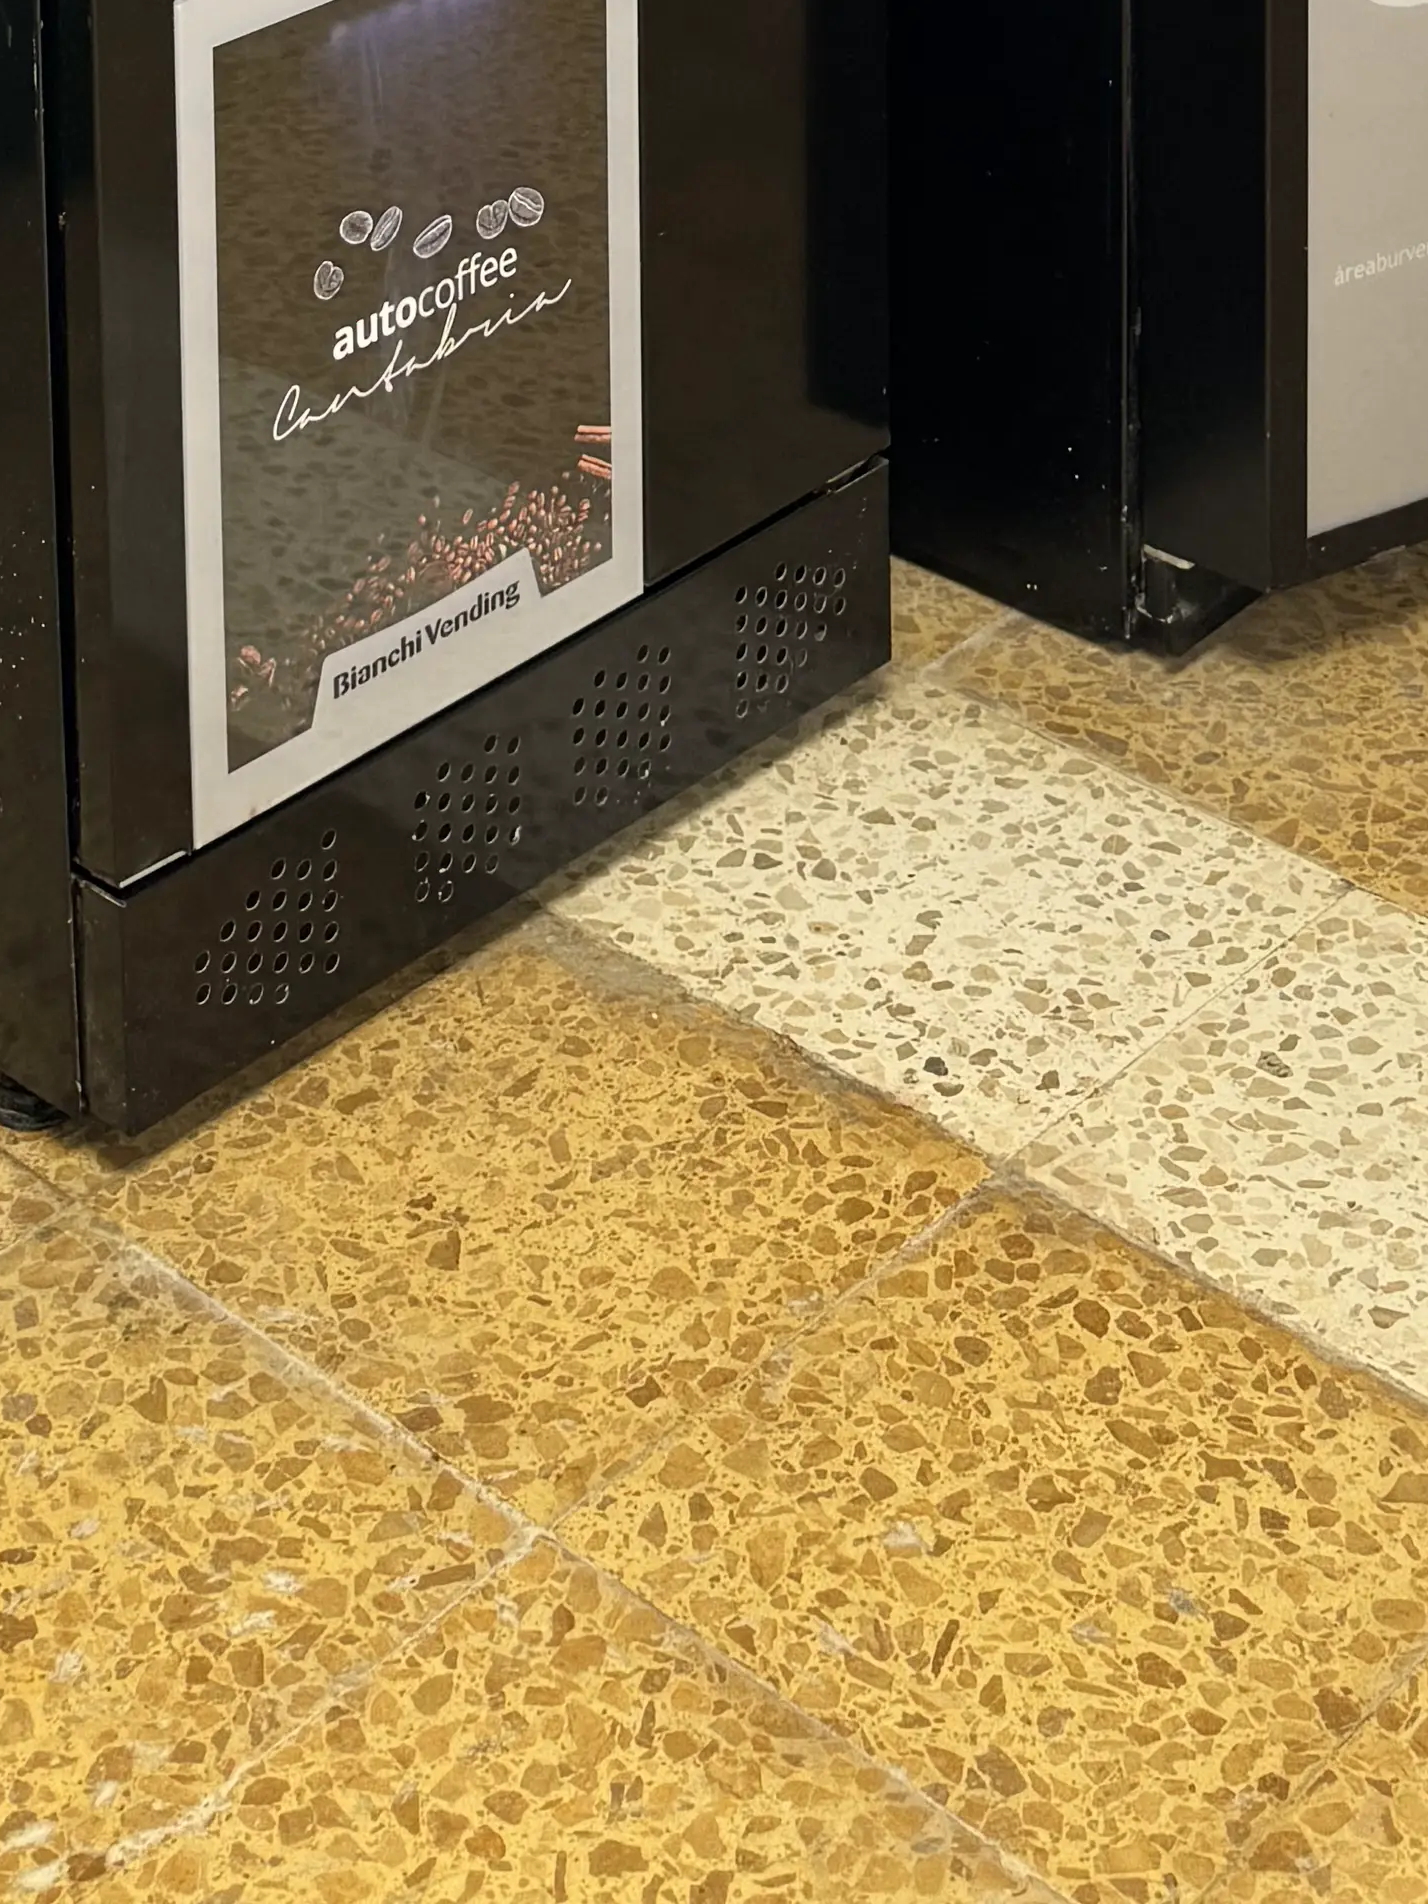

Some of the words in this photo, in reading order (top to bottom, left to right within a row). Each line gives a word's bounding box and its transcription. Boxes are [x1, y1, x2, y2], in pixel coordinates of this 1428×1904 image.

[272, 277, 573, 442] Cantabria
[332, 246, 519, 361] autocoffee
[332, 629, 423, 700] Bianchi
[424, 579, 521, 646] Vending
